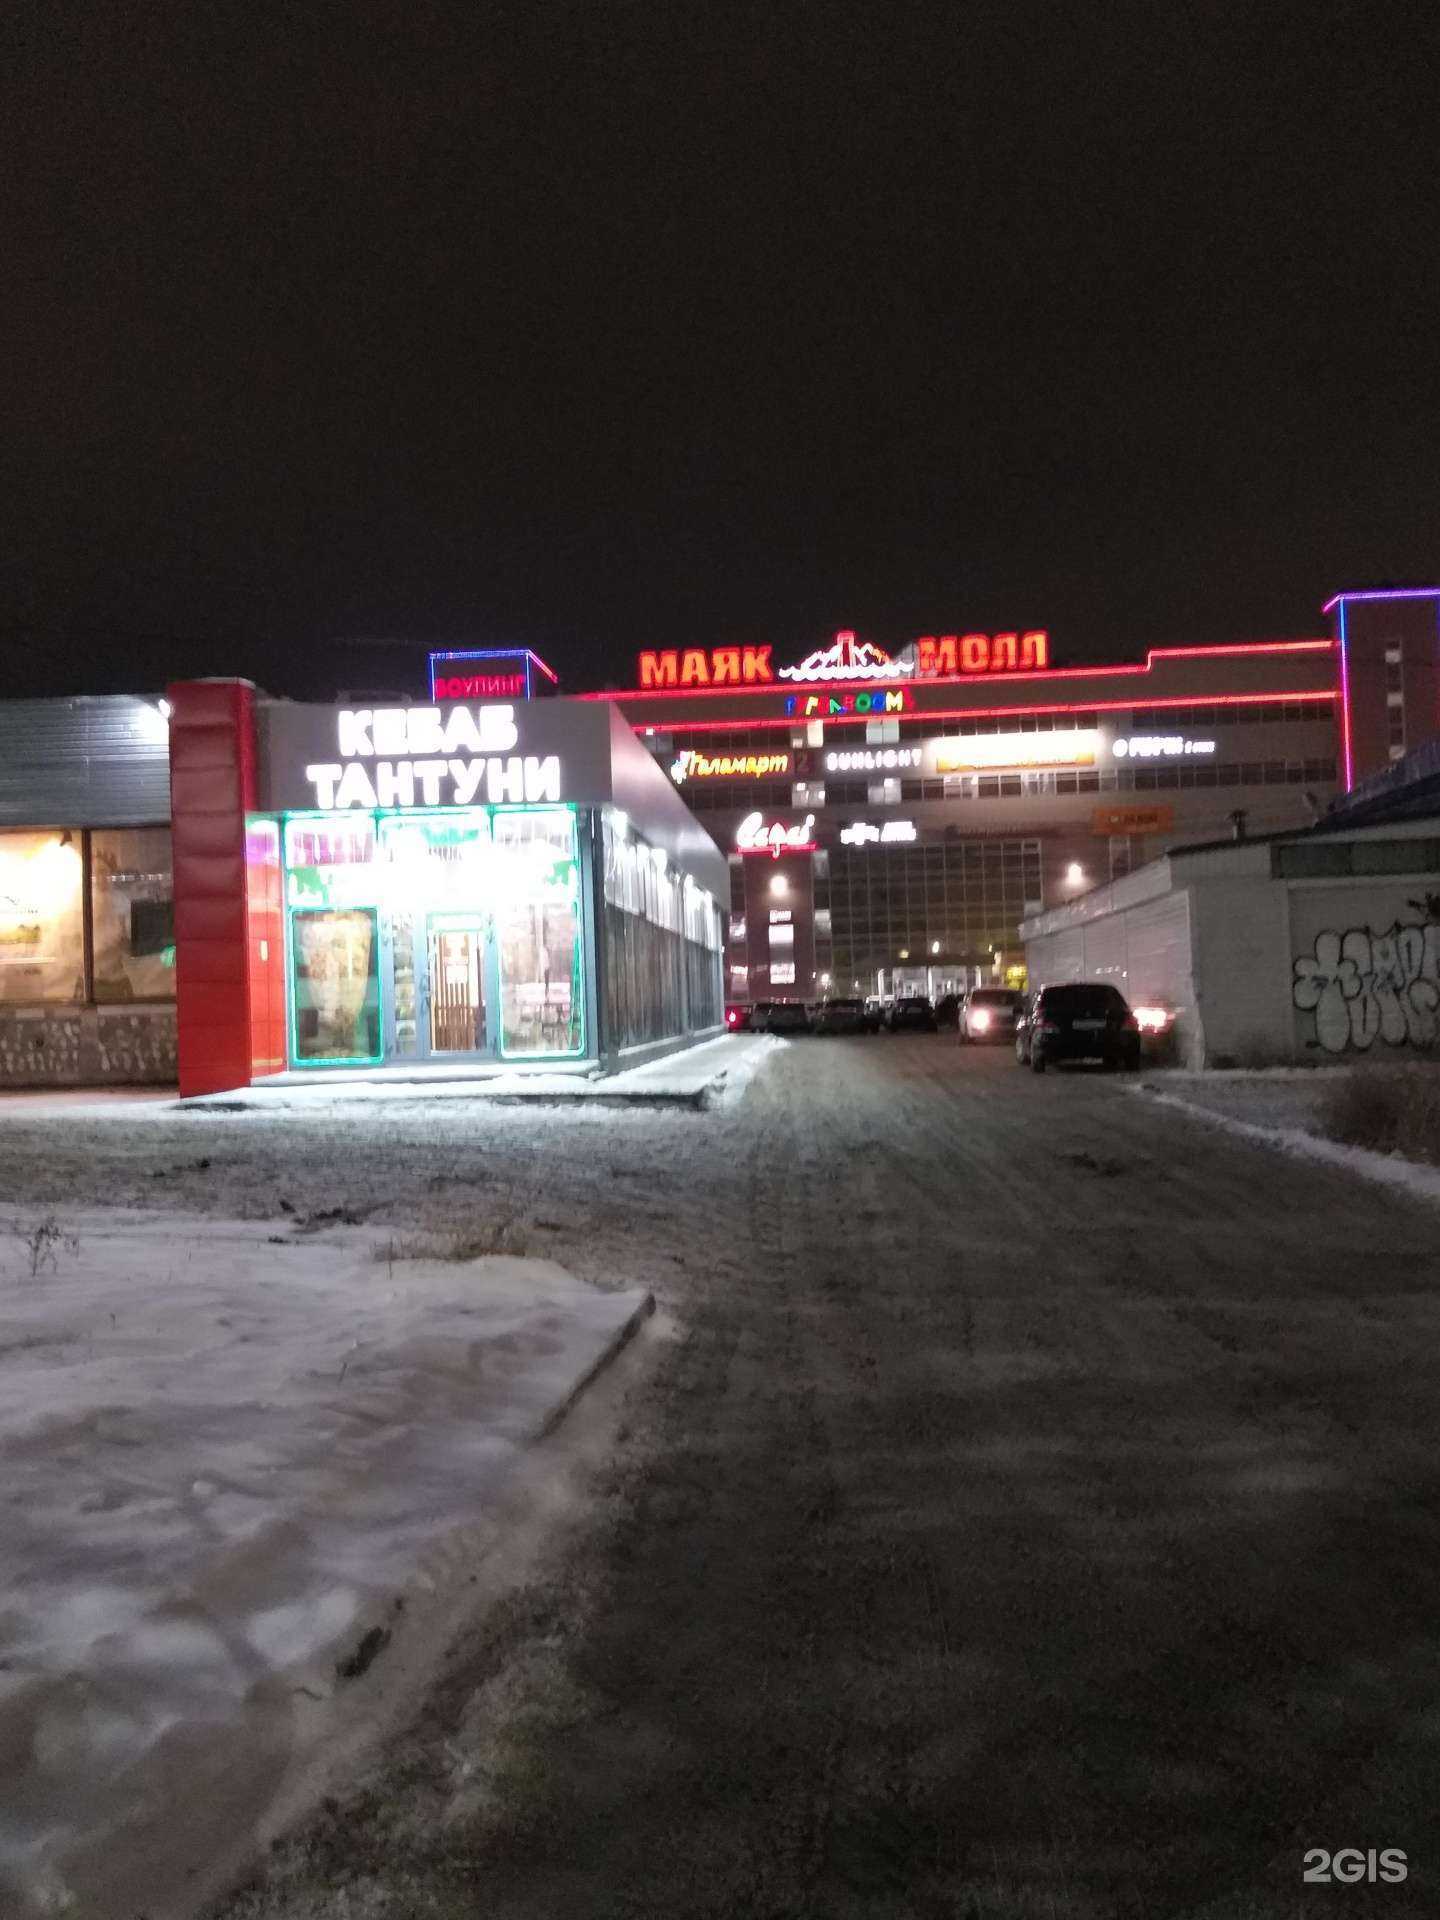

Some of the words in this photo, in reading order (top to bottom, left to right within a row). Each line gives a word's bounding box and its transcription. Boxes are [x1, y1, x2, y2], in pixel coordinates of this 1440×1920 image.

[640, 645, 772, 688] МАЯК
[918, 631, 1049, 673] МОЛЛ
[338, 704, 518, 757] КЕБАБ
[306, 756, 561, 809] ТАНТУНИ
